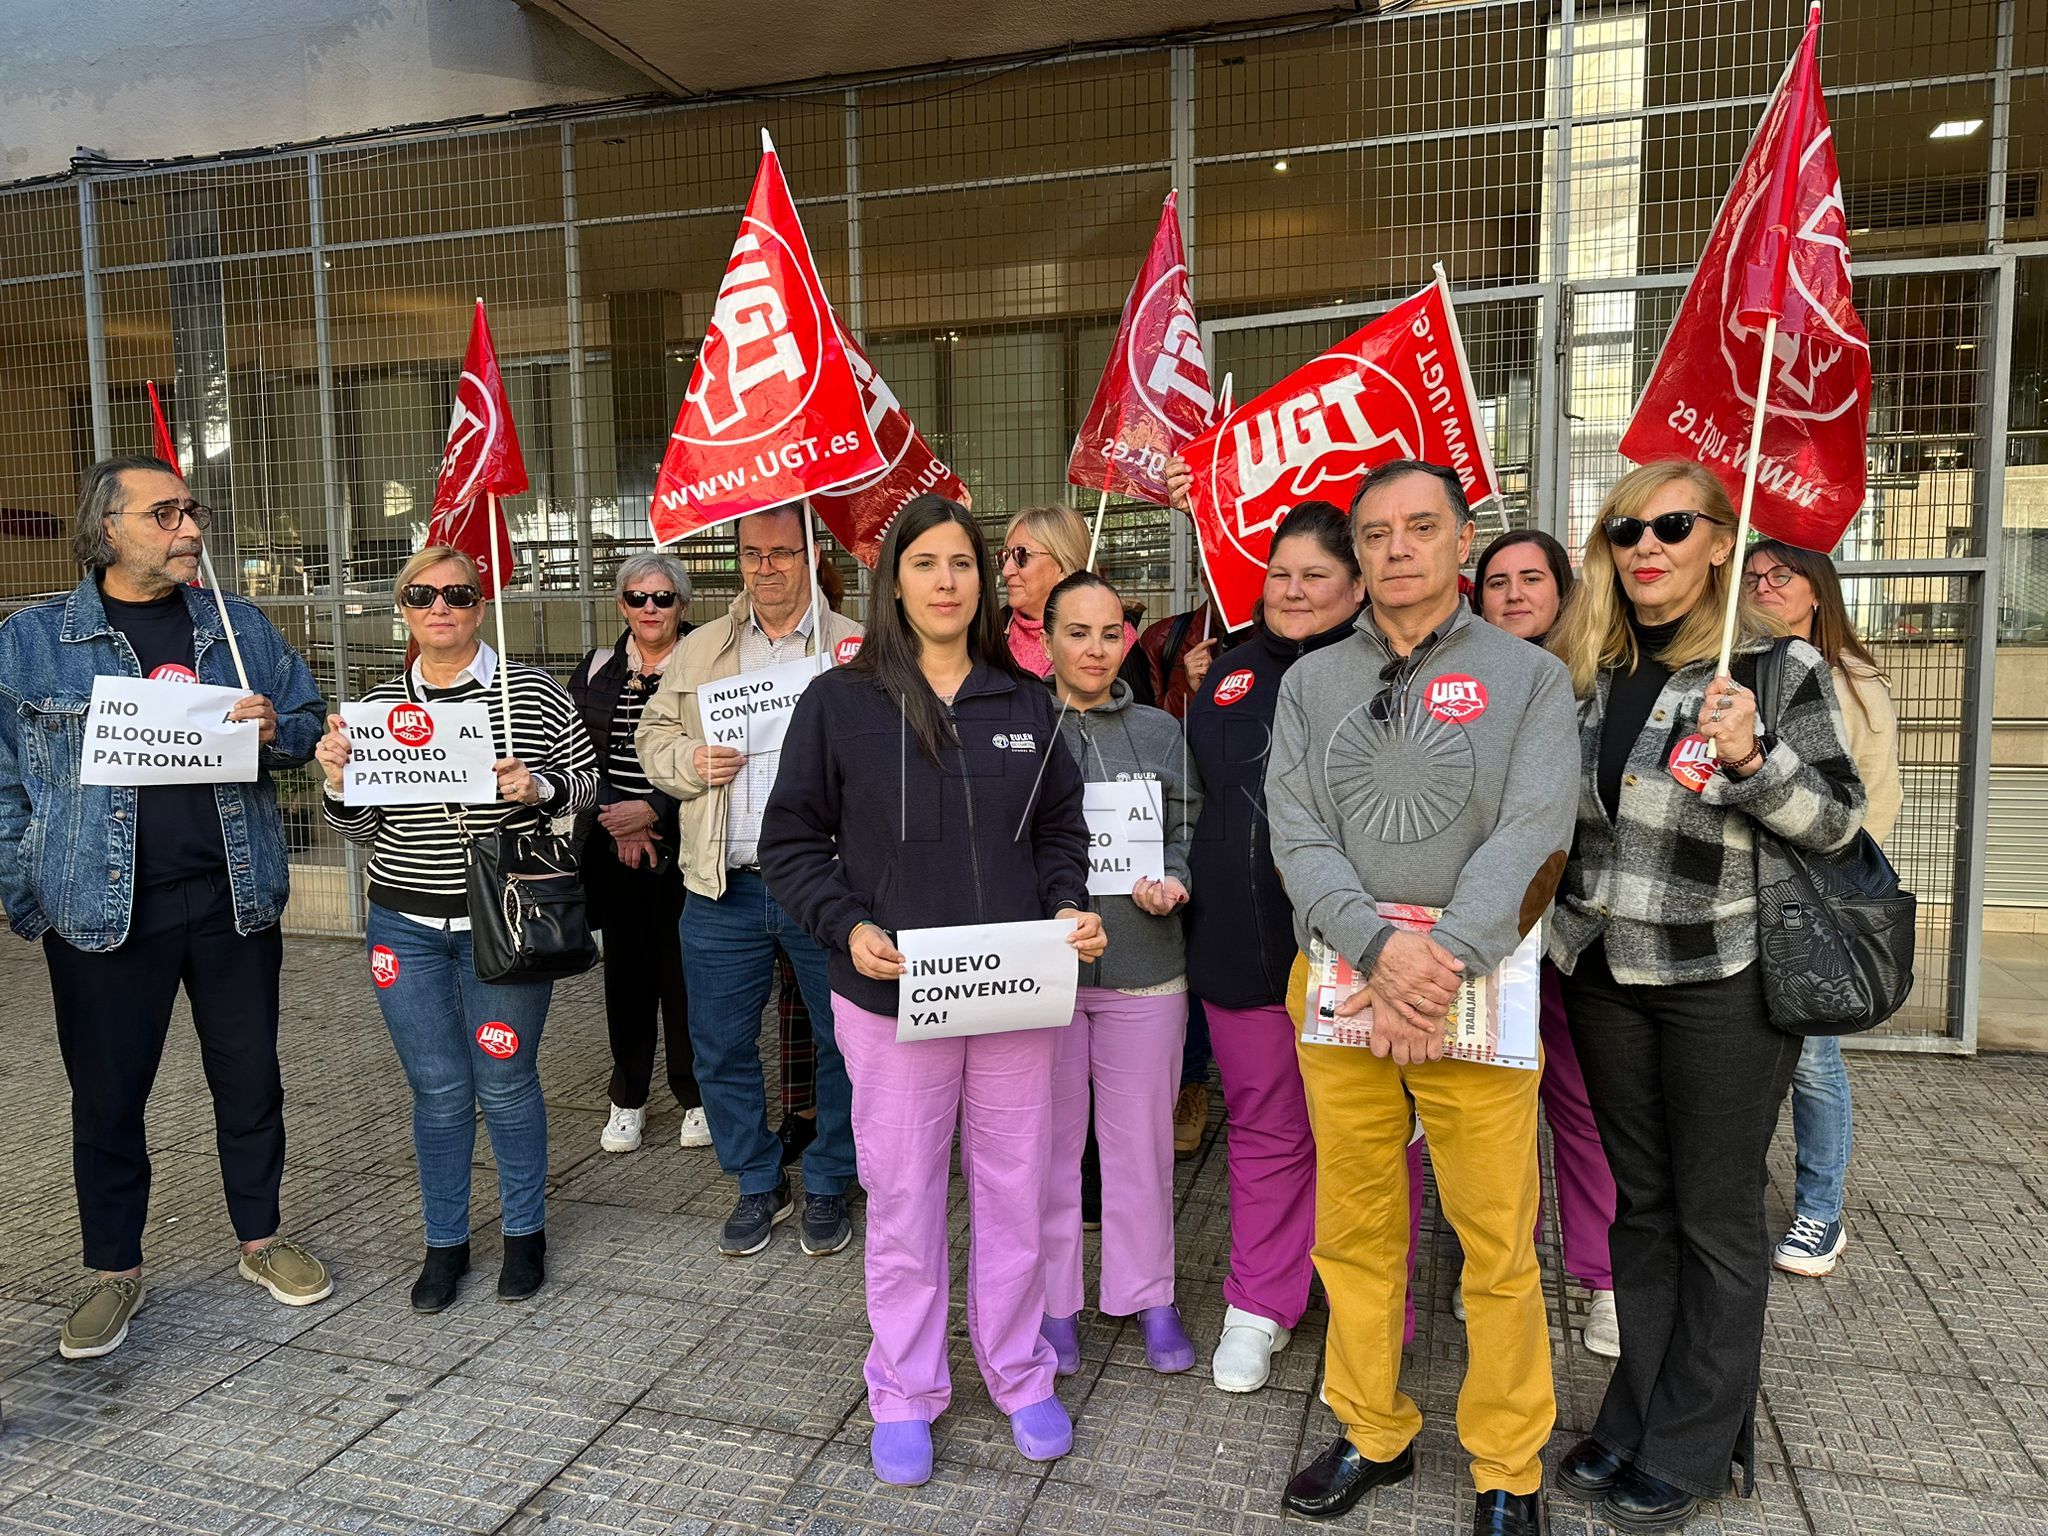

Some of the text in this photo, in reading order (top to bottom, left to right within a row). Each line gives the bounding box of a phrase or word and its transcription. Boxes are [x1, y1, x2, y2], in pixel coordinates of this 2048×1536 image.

[1233, 371, 1366, 494] UGT
[660, 430, 860, 511] www.UGT.es
[840, 641, 862, 656] UG
[1219, 673, 1253, 691] UGT
[1431, 681, 1478, 703] UGT
[393, 711, 428, 729] UGT
[96, 725, 202, 746] BLOQUEO
[459, 726, 484, 739] AL
[713, 726, 744, 743] YA!
[1009, 733, 1034, 741] EULEN
[93, 750, 222, 767] PATRONAL!
[353, 748, 447, 764] BLOQUEO
[1677, 740, 1712, 763] UG
[355, 769, 468, 786] PATRONAL!
[1128, 806, 1153, 821] AL
[372, 950, 394, 971] UGT
[911, 977, 1041, 1004] CONVENIO,
[910, 1010, 948, 1026] YA!
[1465, 990, 1476, 1036] TRABAJAR
[481, 1026, 515, 1046] UGT
